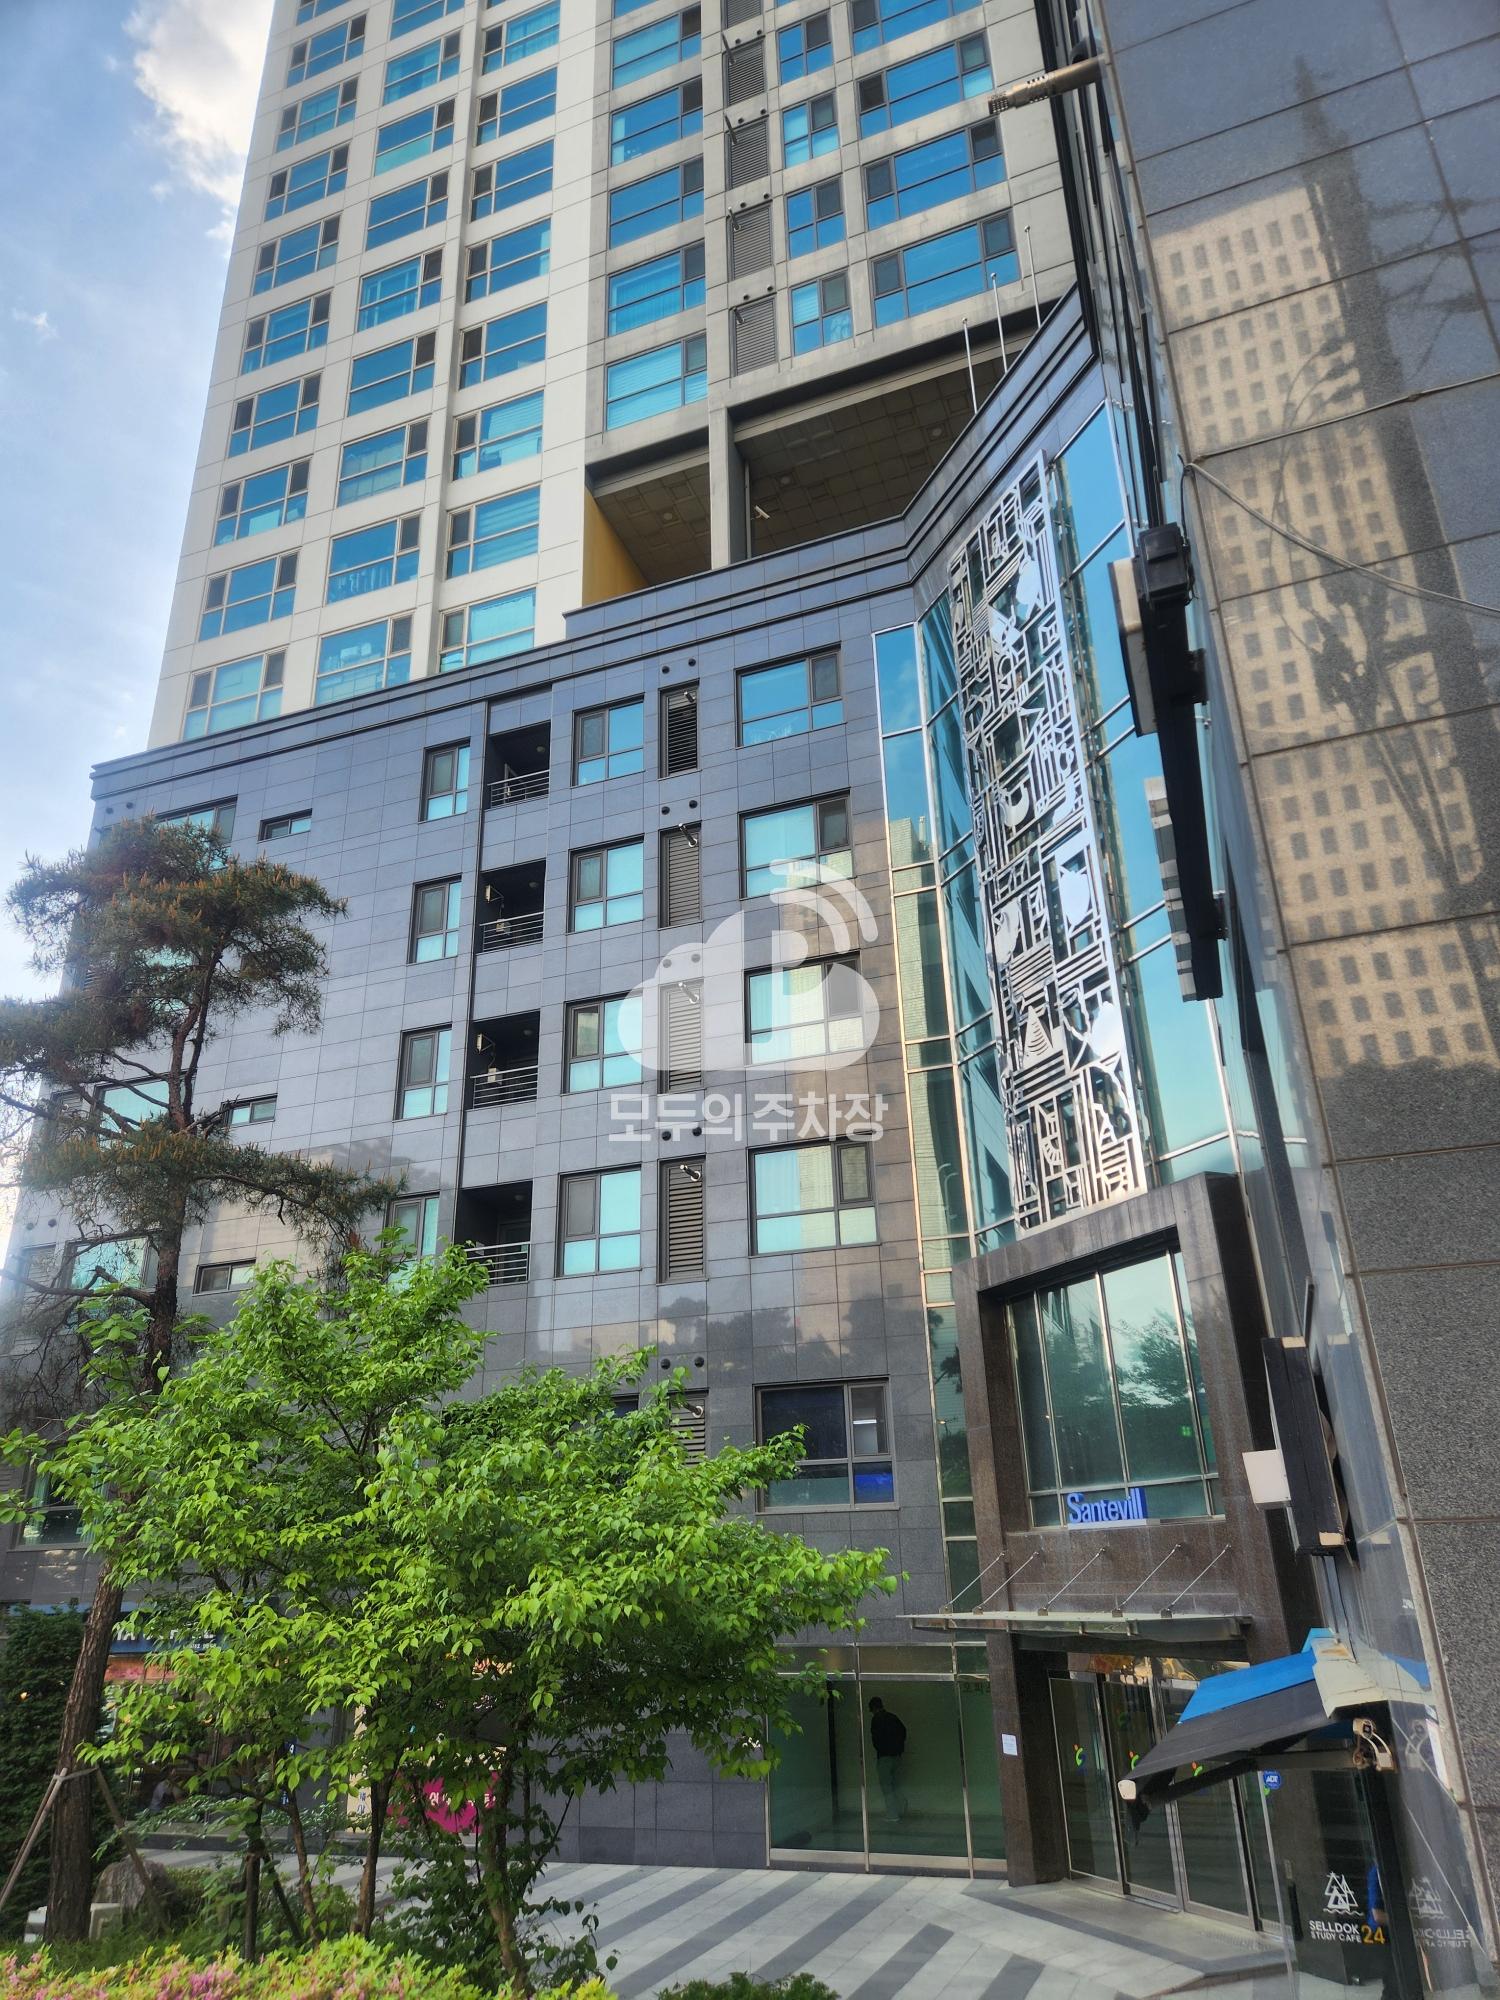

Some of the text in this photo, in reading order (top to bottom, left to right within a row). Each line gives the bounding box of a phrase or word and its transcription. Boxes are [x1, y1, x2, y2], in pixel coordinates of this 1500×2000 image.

[1067, 1487, 1145, 1523] Santevill
[1309, 1920, 1359, 1935] SELLDOK
[1361, 1924, 1385, 1944] 24
[1311, 1931, 1361, 1943] STUDY CAFE
